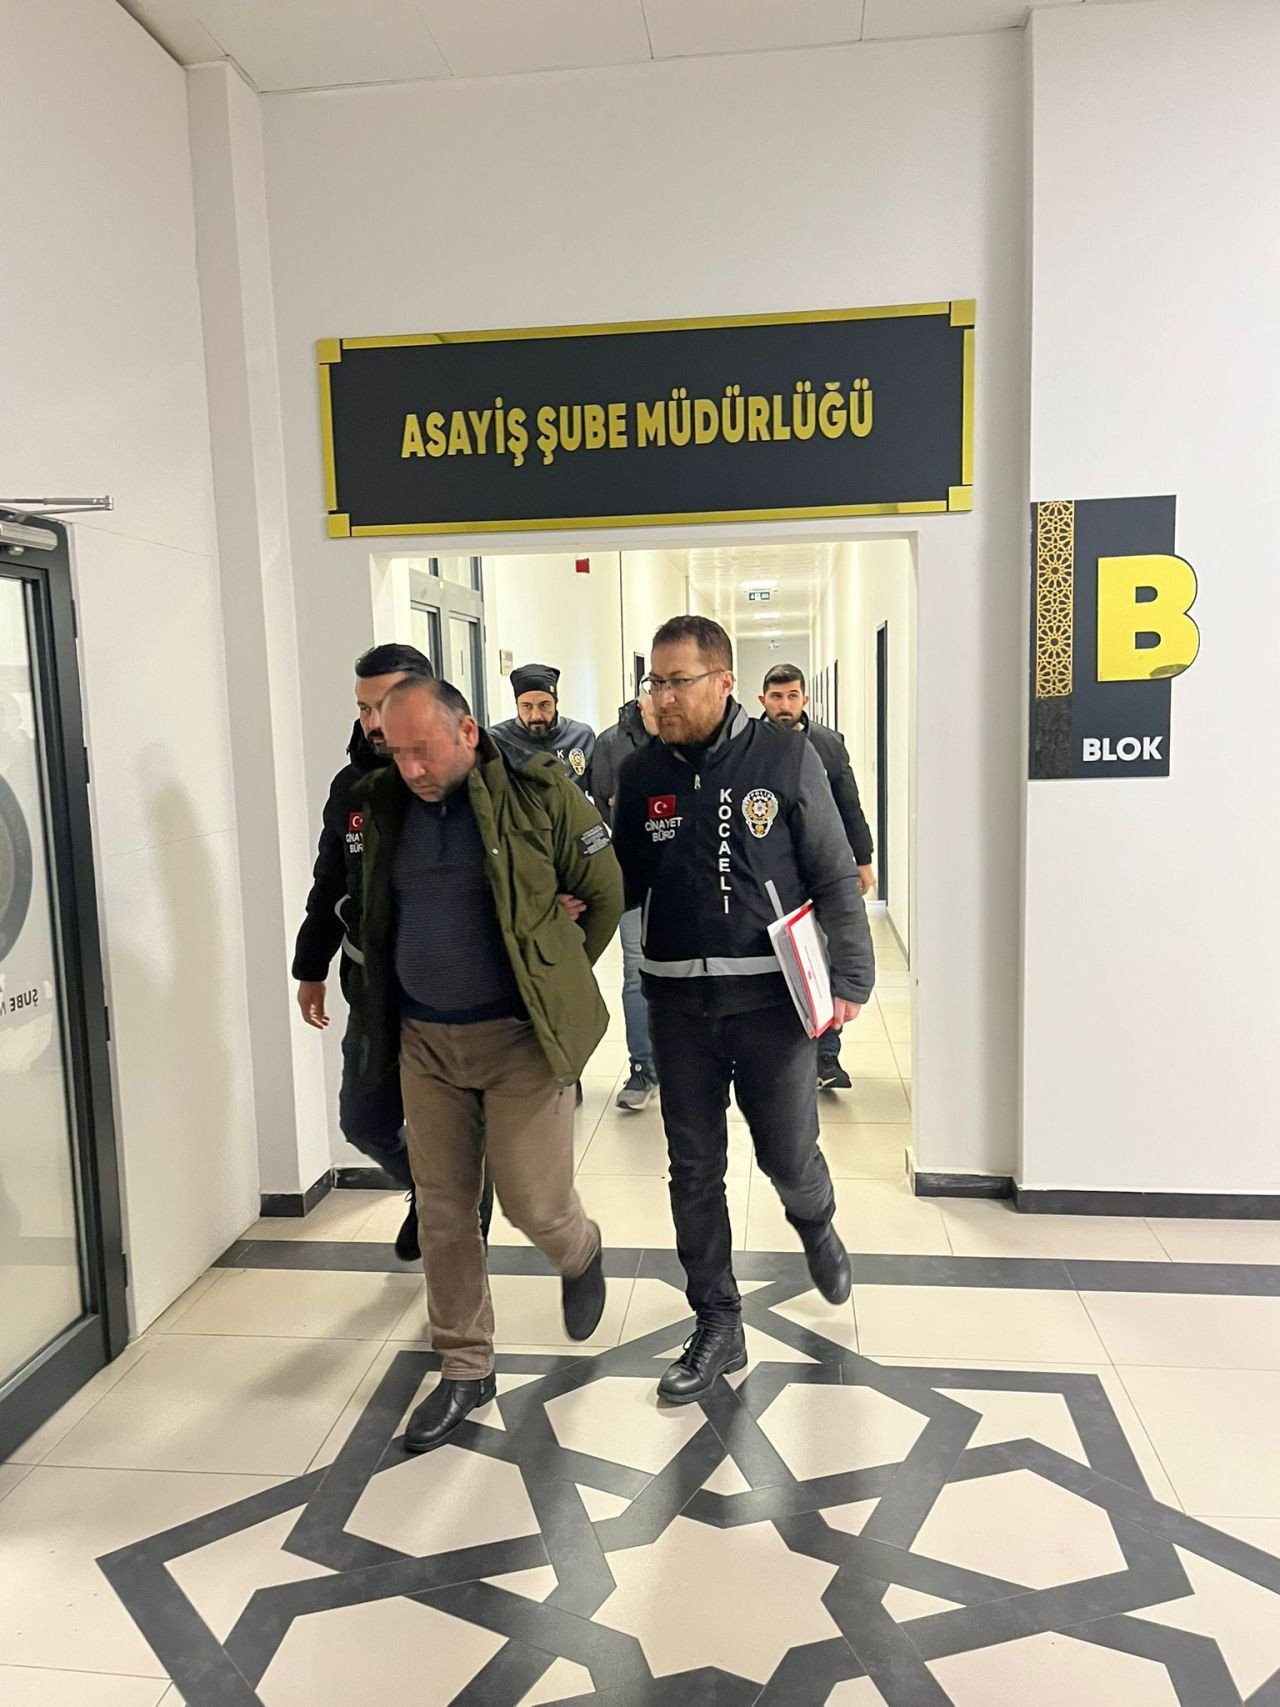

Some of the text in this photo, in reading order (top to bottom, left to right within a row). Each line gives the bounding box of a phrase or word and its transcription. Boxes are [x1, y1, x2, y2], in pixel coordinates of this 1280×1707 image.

[401, 378, 873, 467] ASAYİŞ ŞUBE MÜDÜRLÜĞÜ
[1098, 554, 1200, 682] B
[1082, 736, 1163, 762] BLOK
[718, 788, 732, 914] KOCAELİ
